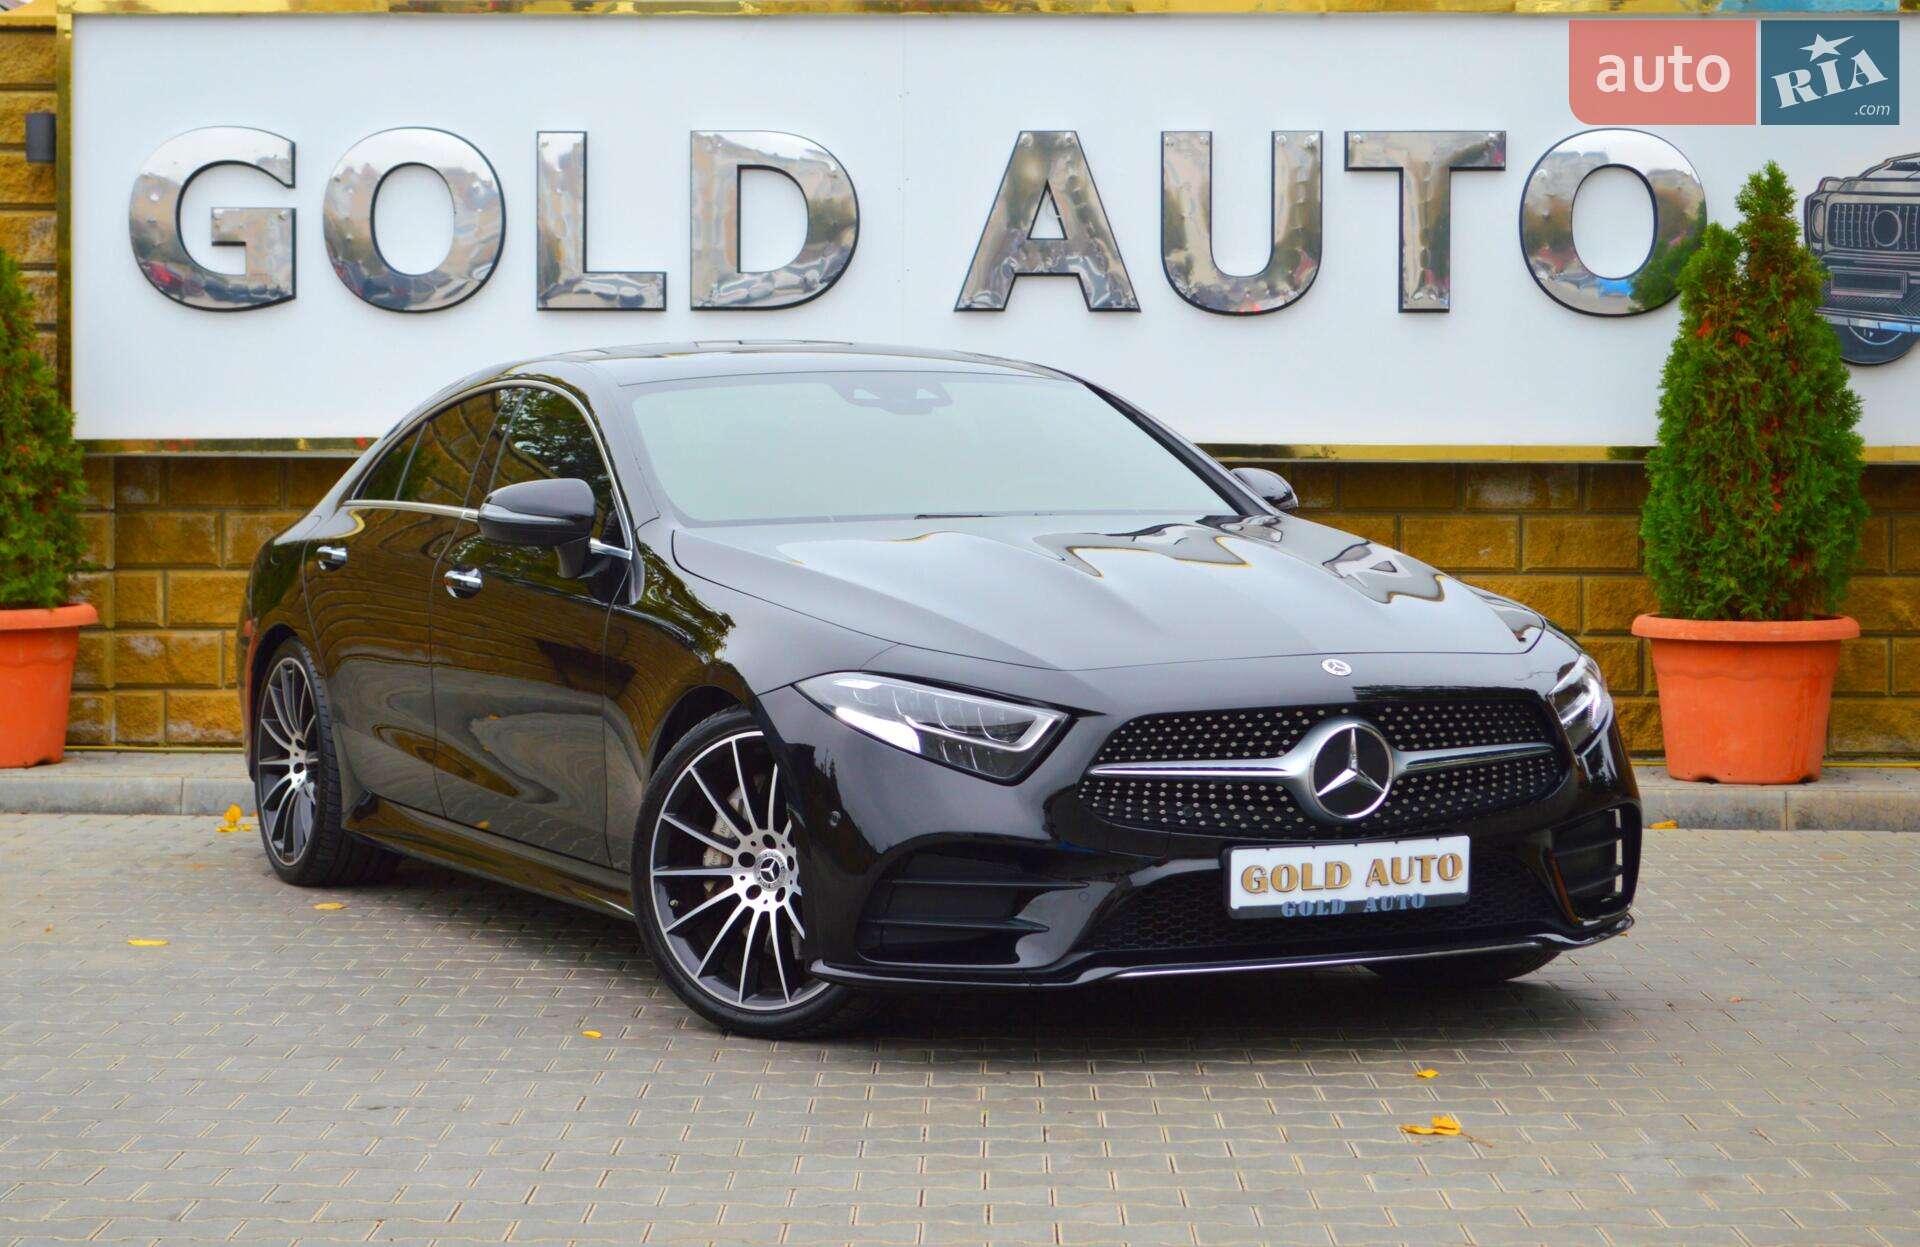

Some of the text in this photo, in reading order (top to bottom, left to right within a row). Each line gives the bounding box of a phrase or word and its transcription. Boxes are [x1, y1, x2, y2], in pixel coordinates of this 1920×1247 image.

[129, 125, 1708, 318] GOLD AUTO
[1241, 853, 1463, 894] GOLD AUTO
[1281, 893, 1426, 917] GOLD AUTO
